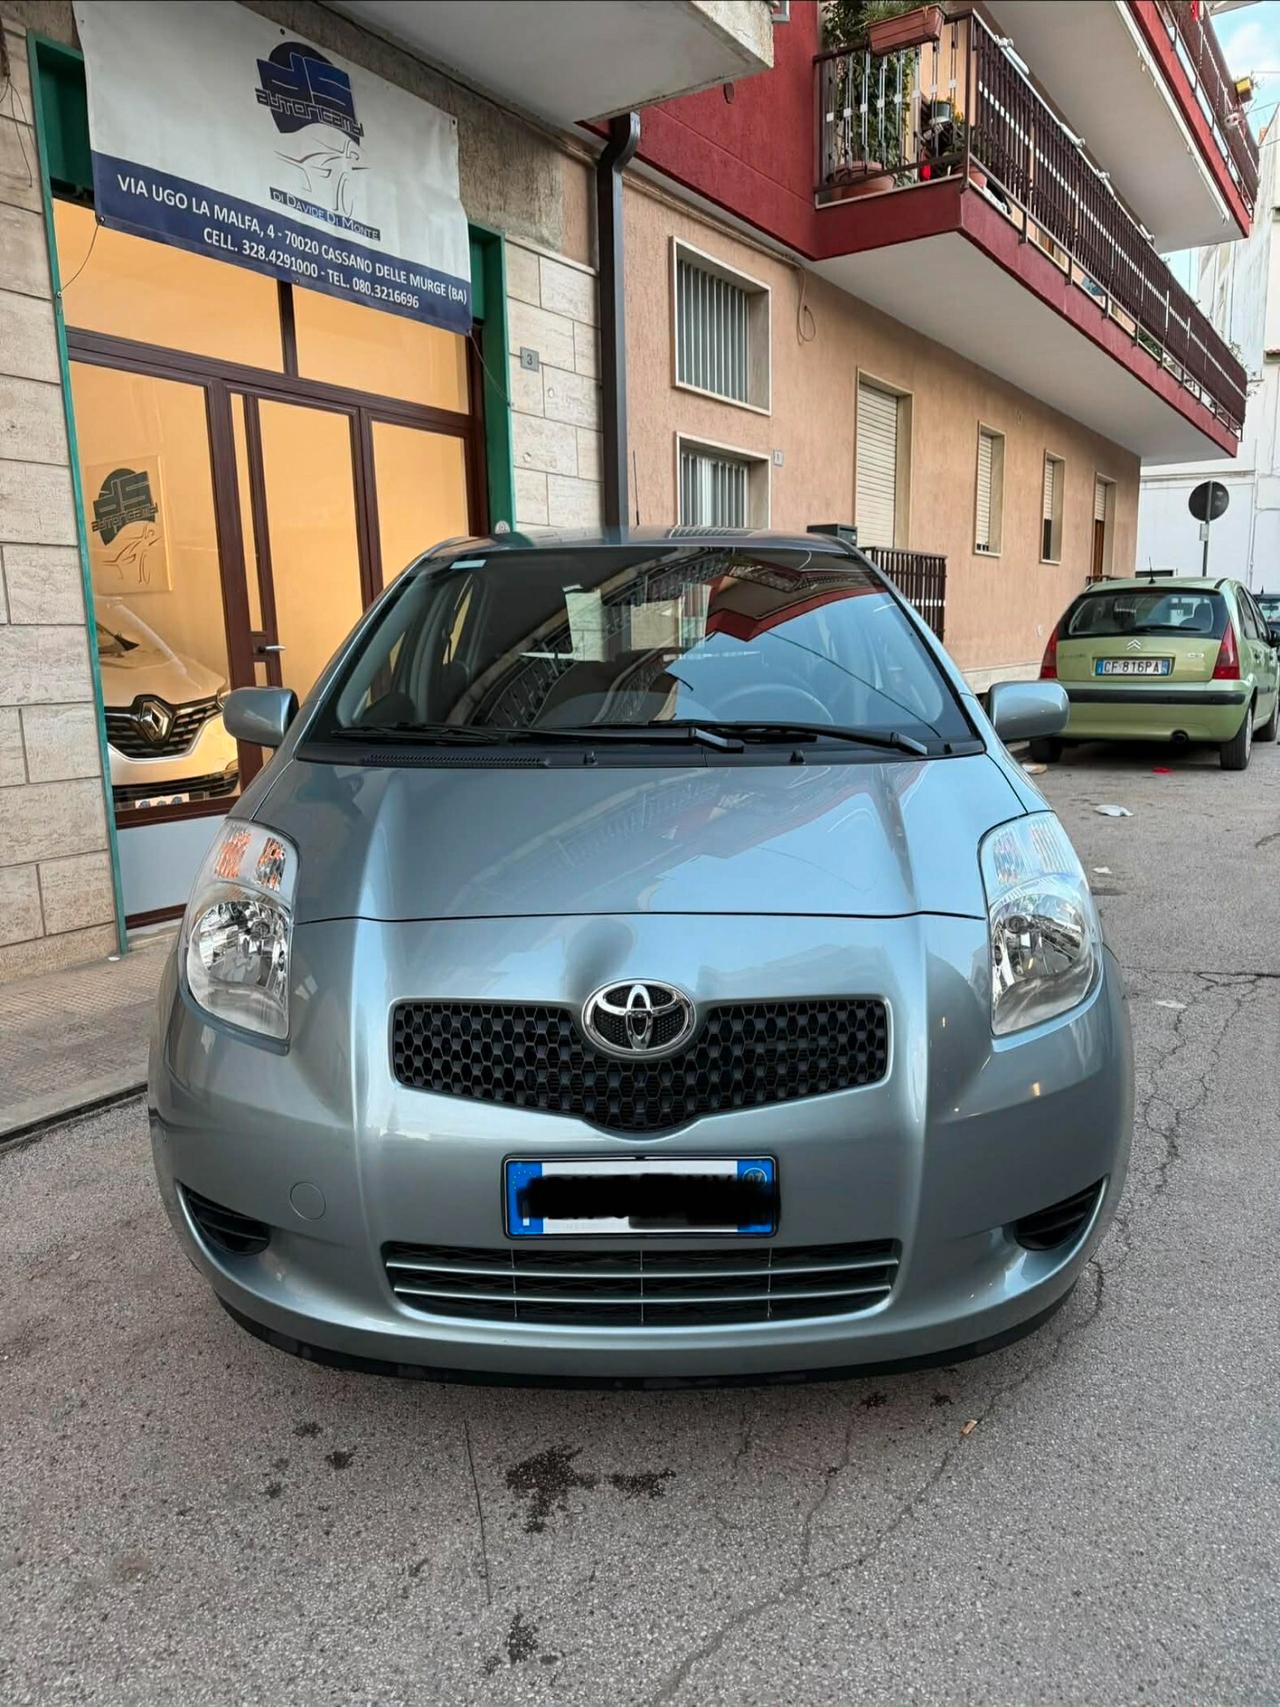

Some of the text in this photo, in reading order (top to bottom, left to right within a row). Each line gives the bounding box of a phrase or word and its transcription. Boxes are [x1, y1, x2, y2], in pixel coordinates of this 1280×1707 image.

[117, 174, 149, 198] VIA
[152, 184, 188, 209] UGO
[192, 197, 210, 217] LA
[214, 205, 264, 238] MALFA,
[266, 224, 275, 239] 4
[284, 230, 319, 255] 70020
[321, 244, 372, 273] CASSANO
[375, 263, 407, 285] DELLE
[409, 272, 446, 297] MURGE
[448, 284, 467, 305] (BA)
[203, 227, 238, 252] CELL.
[242, 239, 318, 278] 328.4291000
[327, 269, 350, 289] TEL.
[352, 277, 419, 309] 080.3216696
[526, 353, 533, 366] 3
